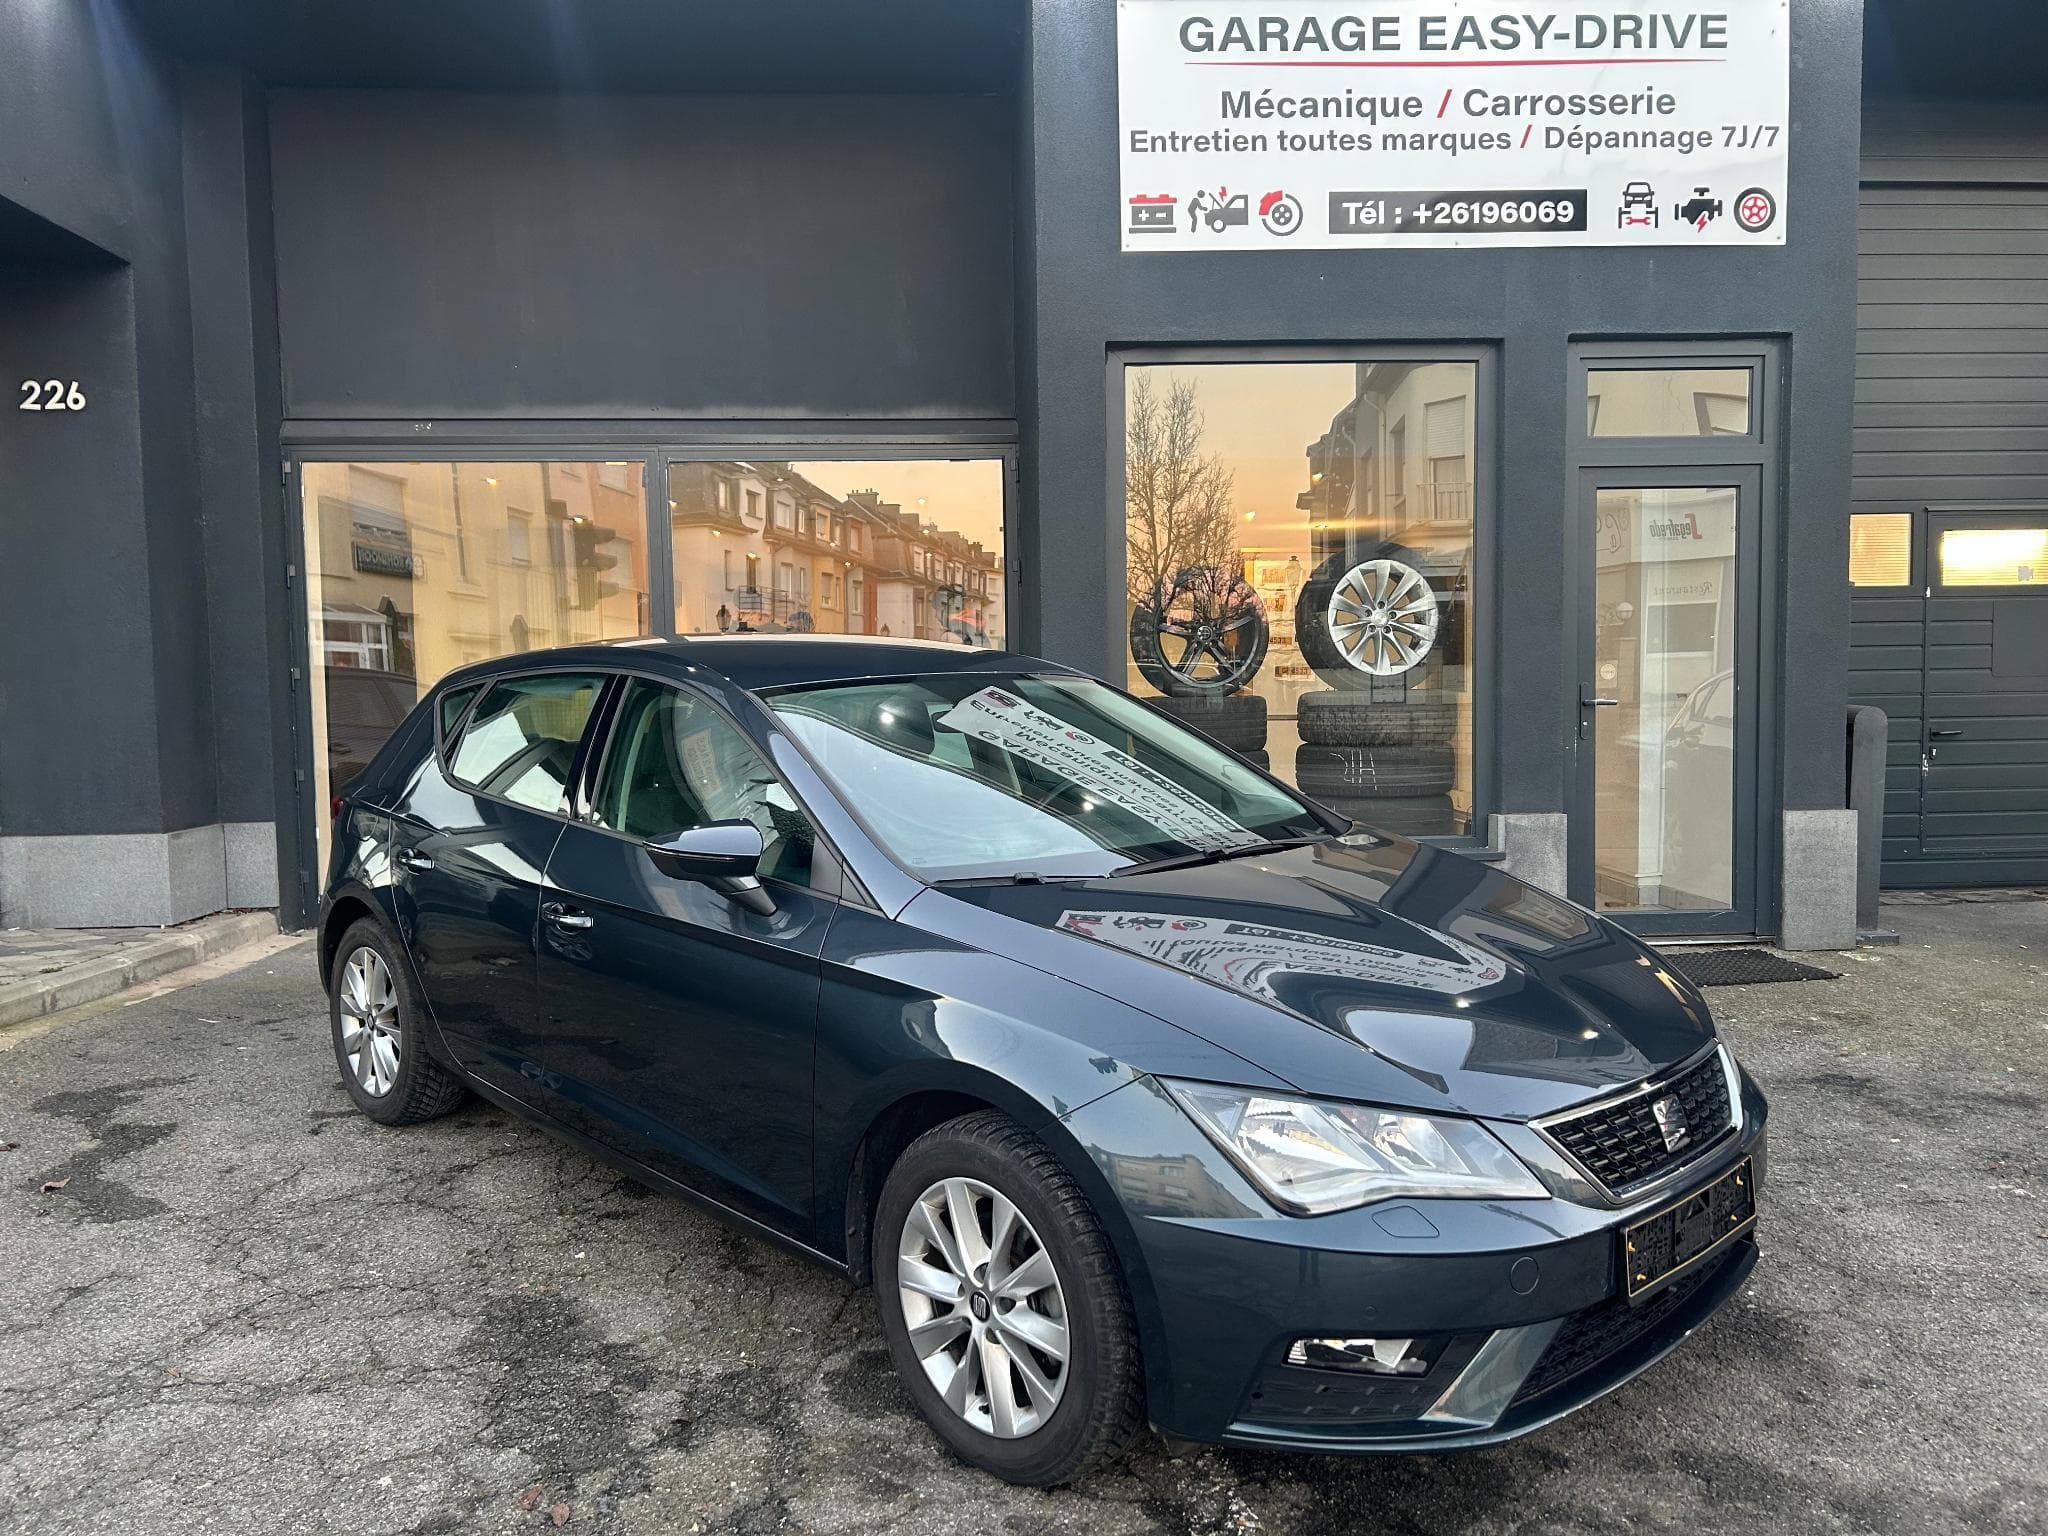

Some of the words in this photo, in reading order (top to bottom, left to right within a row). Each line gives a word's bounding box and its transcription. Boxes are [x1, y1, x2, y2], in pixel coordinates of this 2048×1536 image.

[1179, 16, 1401, 52] GARAGE
[1419, 14, 1729, 51] EASY-DRIVE
[1221, 88, 1423, 126] Mécanique
[1463, 86, 1676, 117] Carrosserie
[1130, 128, 1268, 153] Entretien
[1276, 129, 1373, 151] toutes
[1381, 130, 1512, 157] marques
[1544, 124, 1713, 155] Dépannage
[1721, 125, 1781, 149] 7J/7
[1341, 200, 1385, 226] Tél
[1412, 200, 1575, 226] +26196069
[19, 379, 87, 411] 226
